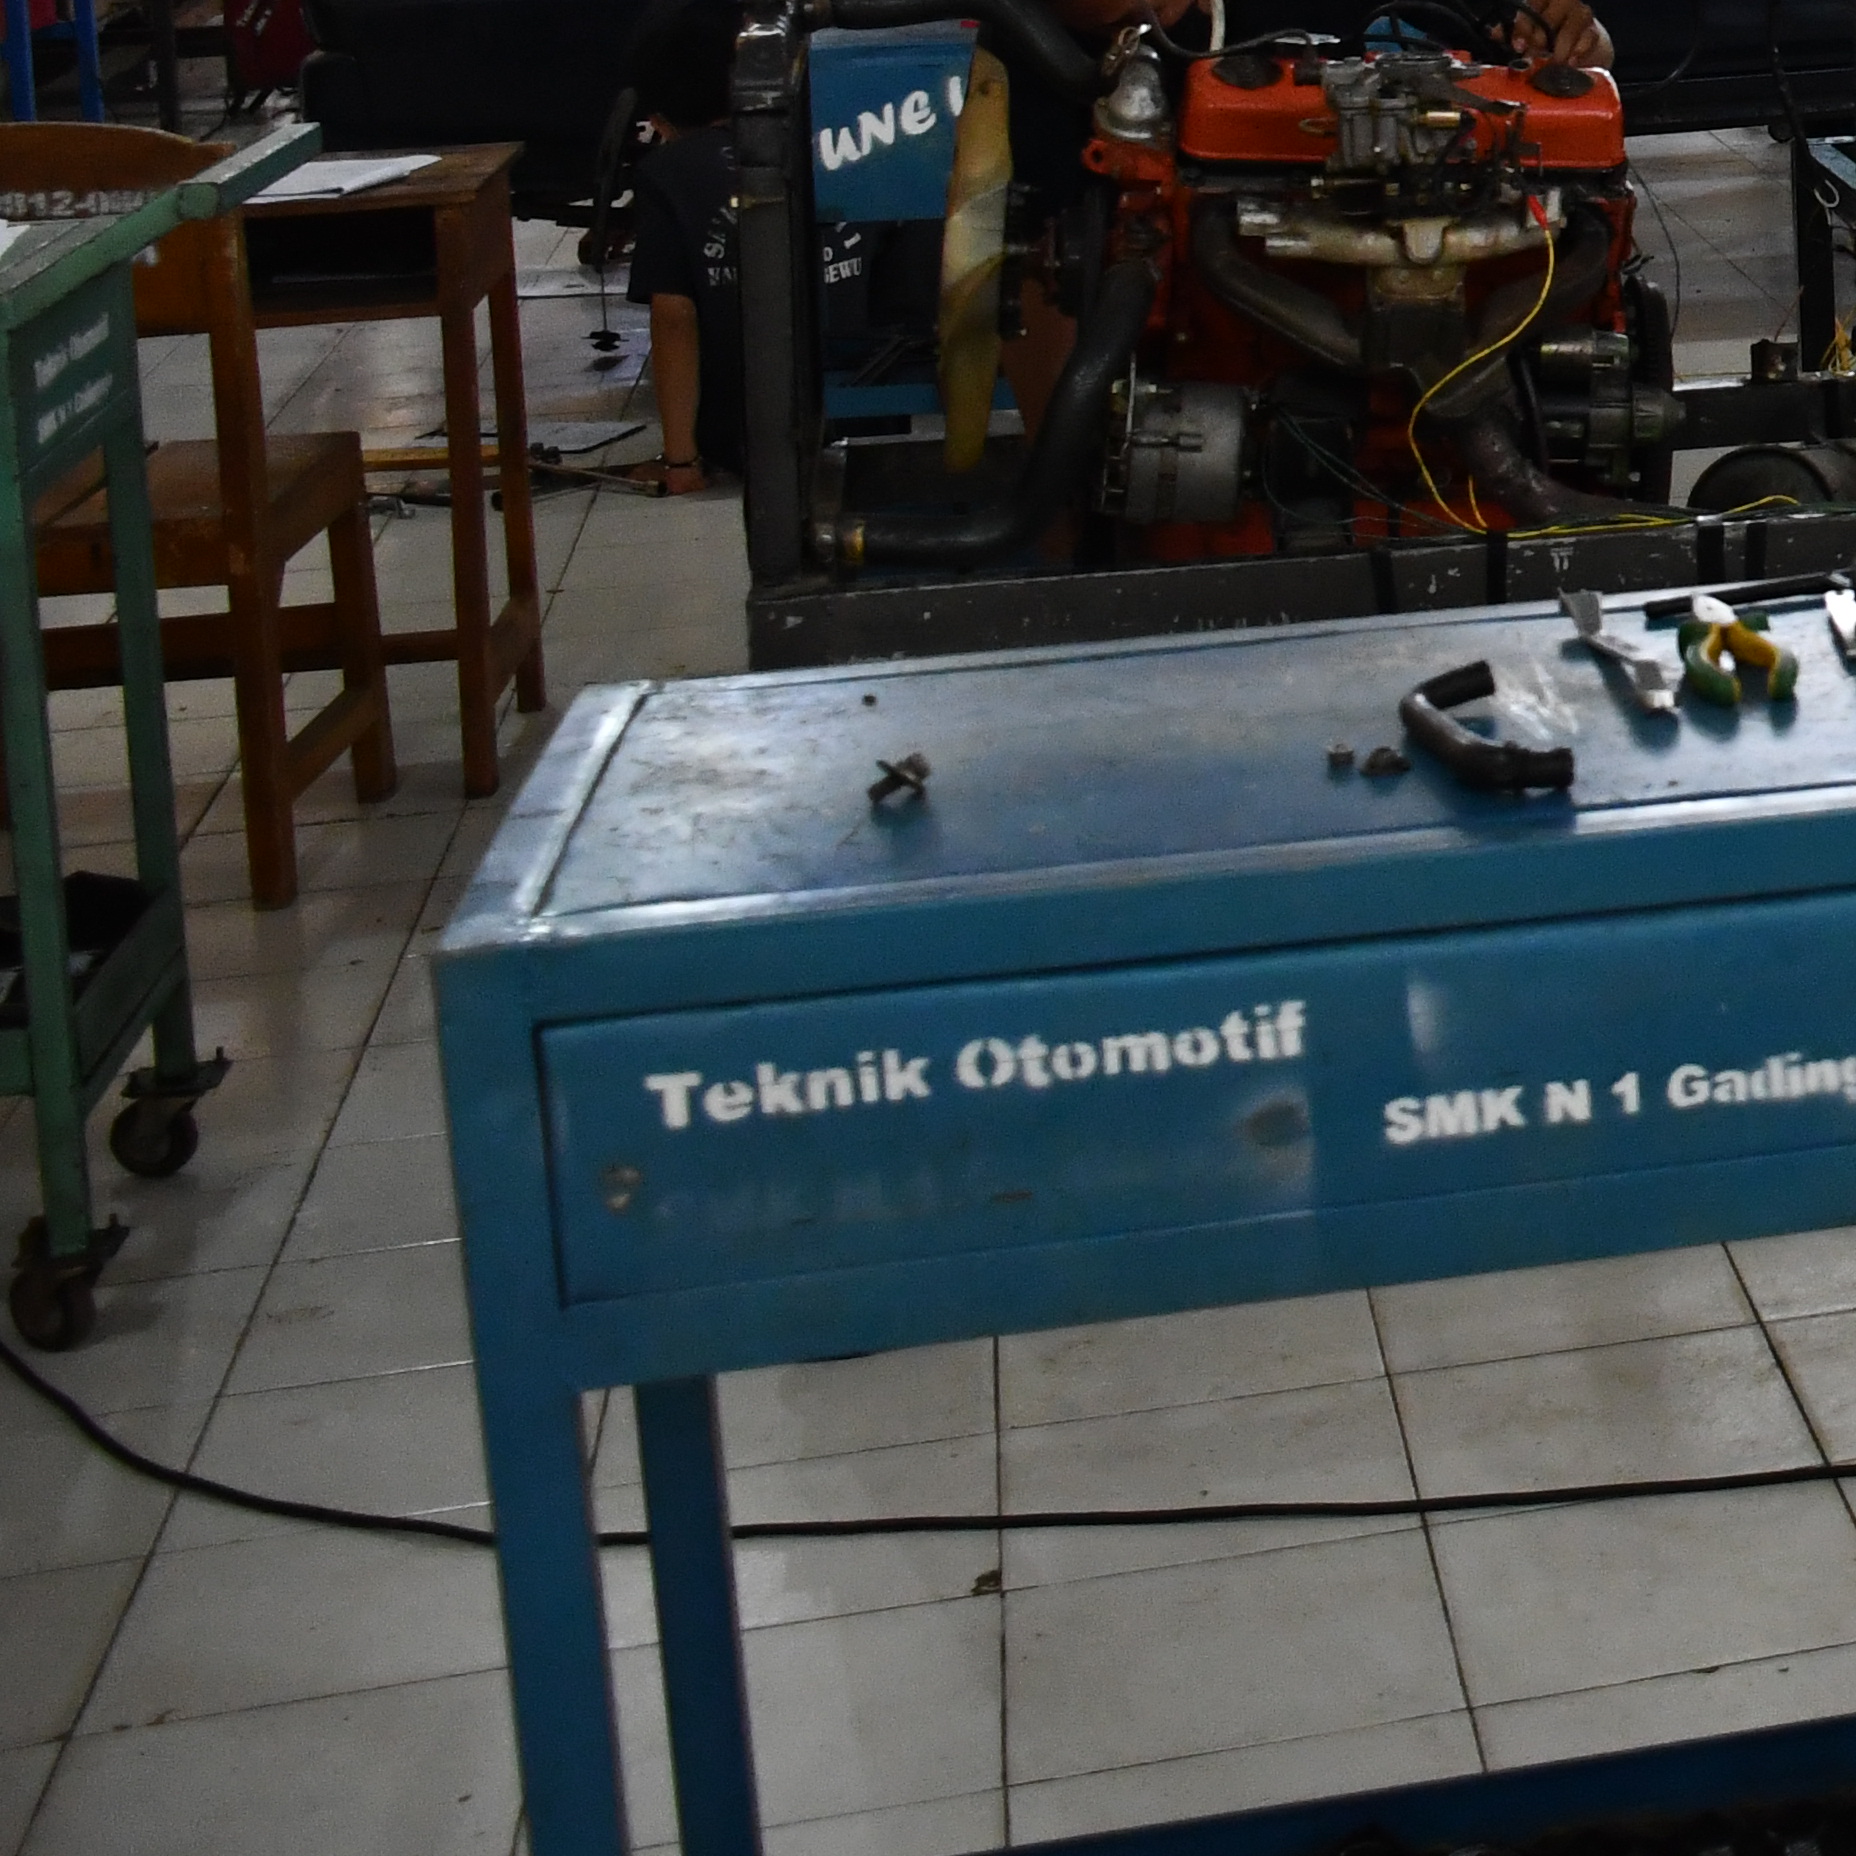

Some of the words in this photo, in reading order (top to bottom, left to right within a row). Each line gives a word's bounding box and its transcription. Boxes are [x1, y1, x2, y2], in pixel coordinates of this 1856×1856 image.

[645, 1049, 930, 1129] Teknik
[956, 1000, 1306, 1090] Otomotif
[1384, 1084, 1525, 1145] SMK
[1545, 1078, 1592, 1124] N
[1610, 1071, 1642, 1114] 1
